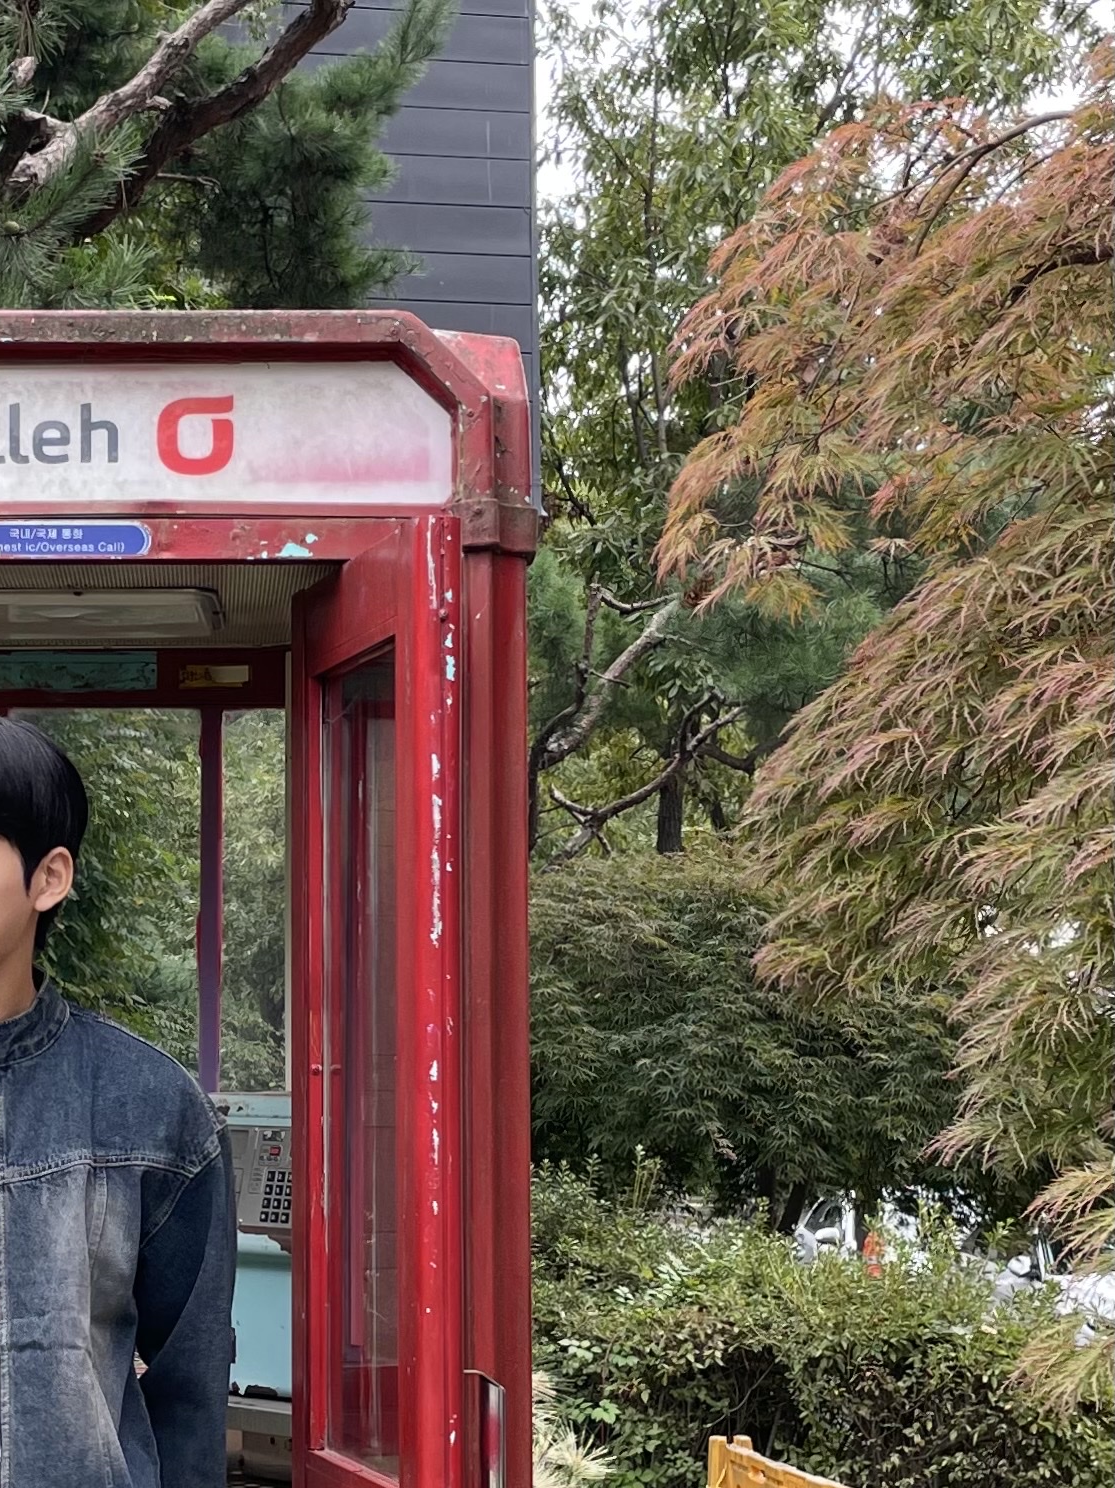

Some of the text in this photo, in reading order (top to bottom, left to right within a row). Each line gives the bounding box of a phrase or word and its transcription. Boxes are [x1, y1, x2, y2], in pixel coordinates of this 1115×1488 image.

[9, 528, 83, 540] 국내/국제 통화
[98, 542, 125, 553] Call)
